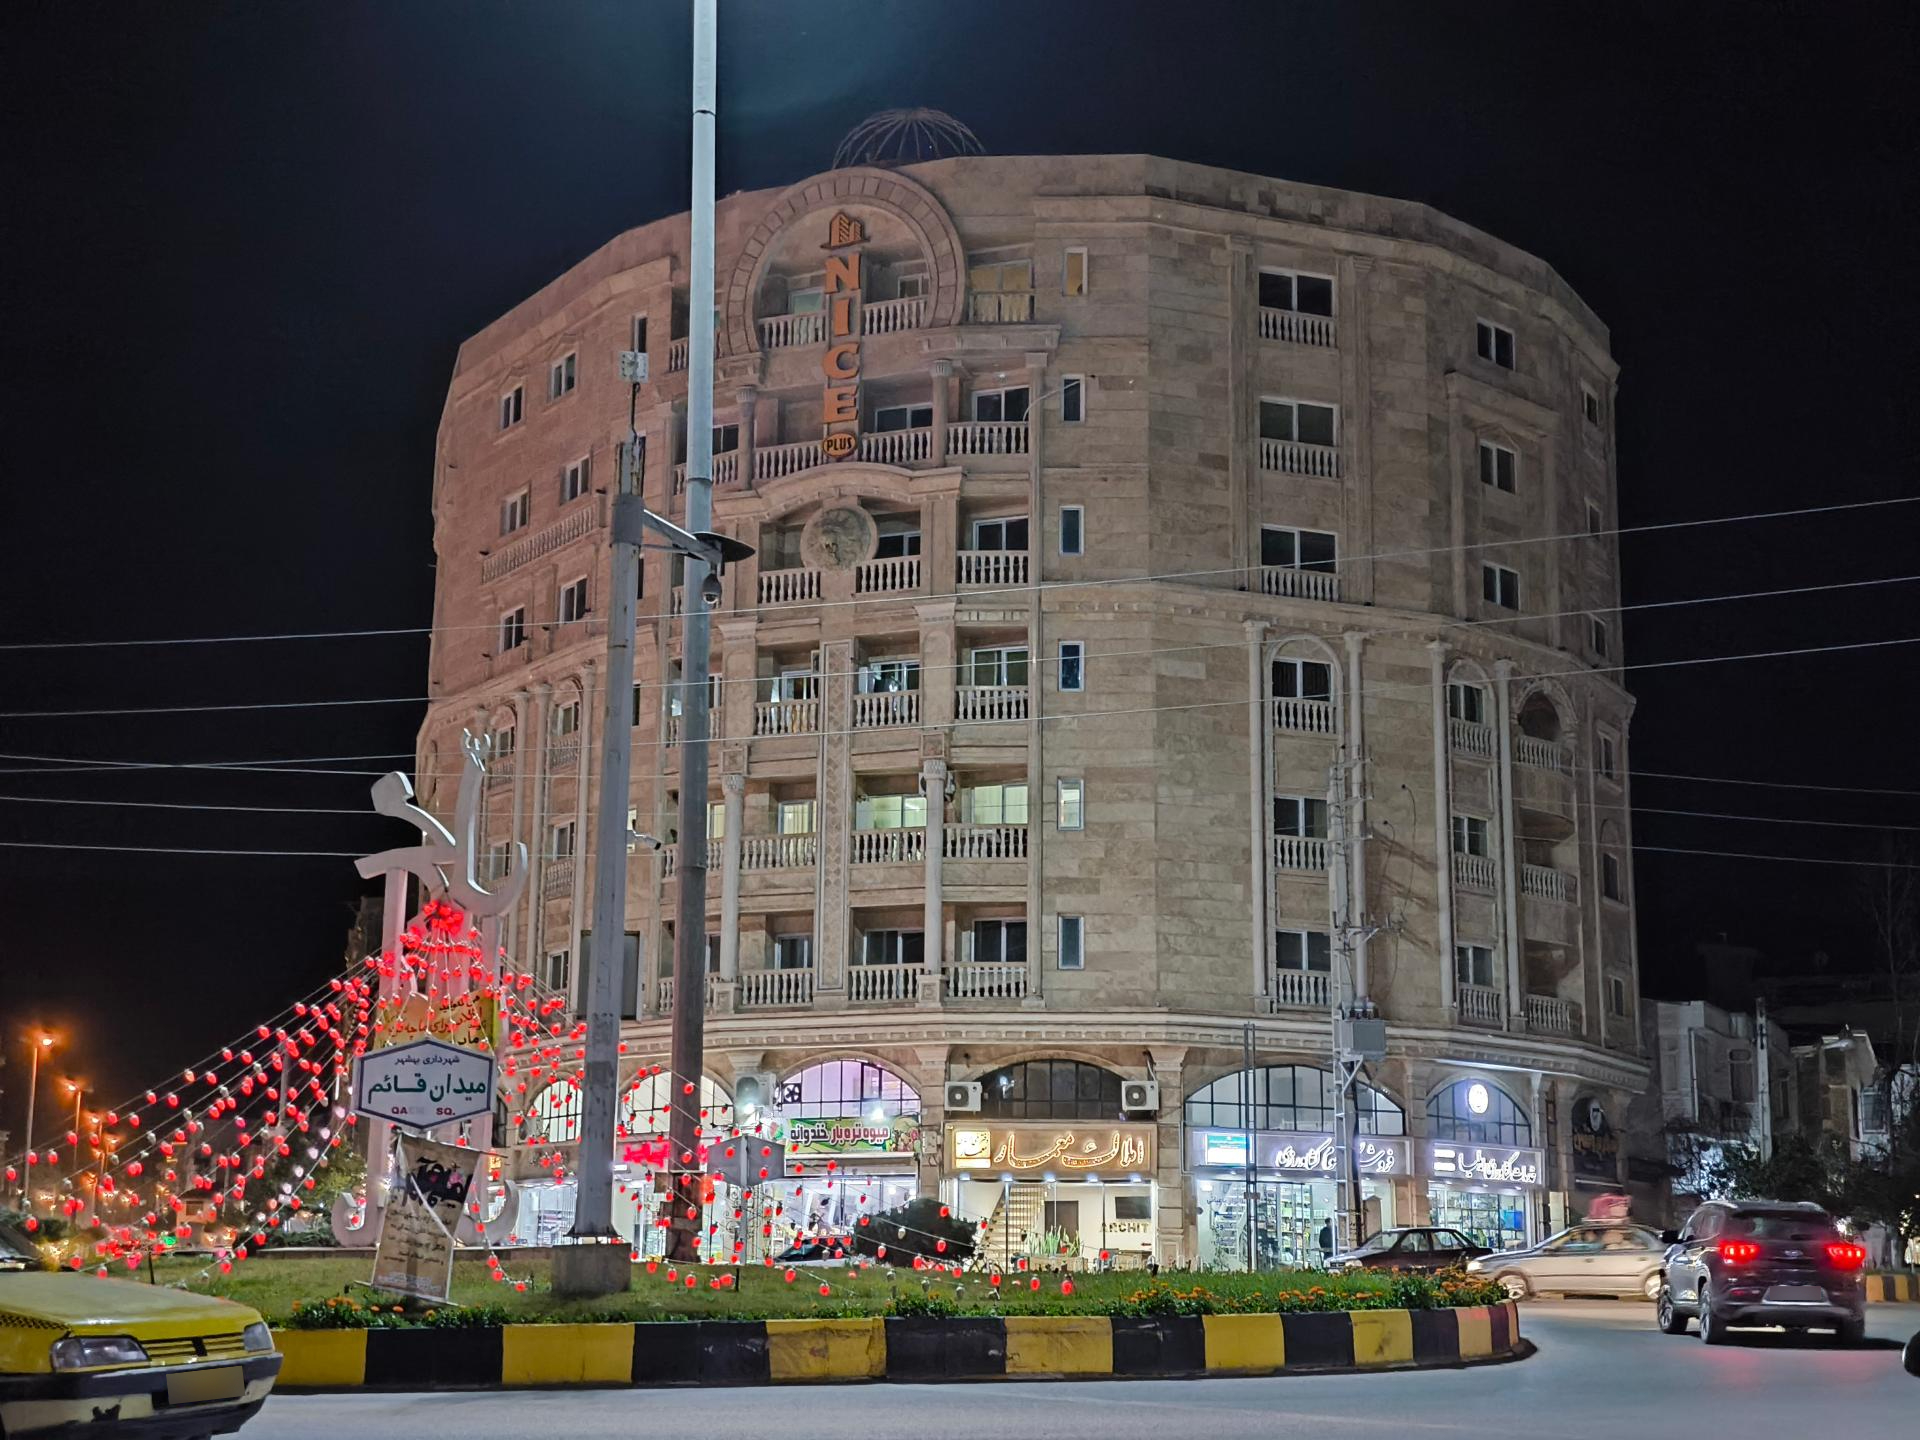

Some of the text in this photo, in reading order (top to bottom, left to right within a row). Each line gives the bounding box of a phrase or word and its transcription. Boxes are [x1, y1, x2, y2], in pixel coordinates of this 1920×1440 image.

[823, 252, 861, 424] NICE
[826, 436, 853, 451] PLUS
[395, 1055, 460, 1065] شهرداری بهشهر
[368, 1072, 486, 1104] میدان قائم
[436, 1107, 456, 1116] SQ.
[790, 1123, 829, 1145] خندوانه
[864, 1126, 889, 1142] میوه
[993, 1131, 1075, 1169] معمار
[1275, 1137, 1333, 1170] کشاورزی
[1483, 1151, 1520, 1181] کشاورزی
